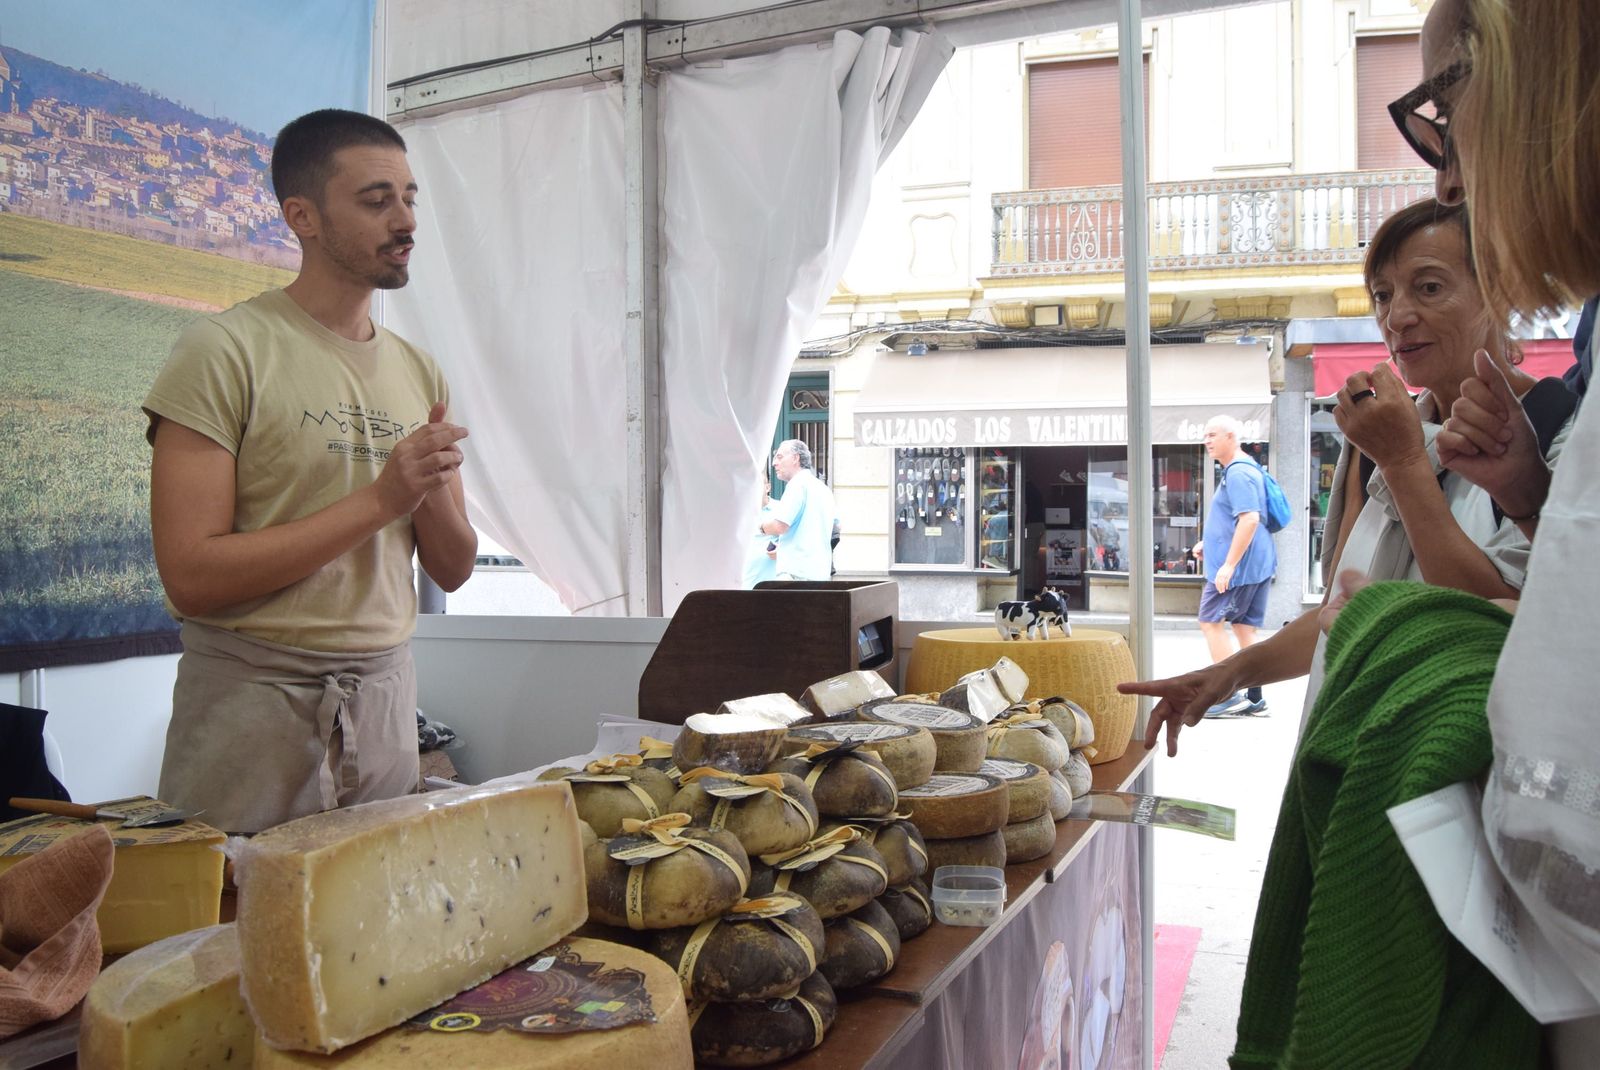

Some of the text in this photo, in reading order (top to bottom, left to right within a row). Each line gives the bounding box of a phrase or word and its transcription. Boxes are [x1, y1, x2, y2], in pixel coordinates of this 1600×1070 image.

[861, 414, 1128, 445] CALZADOS LOS VALENTIN
